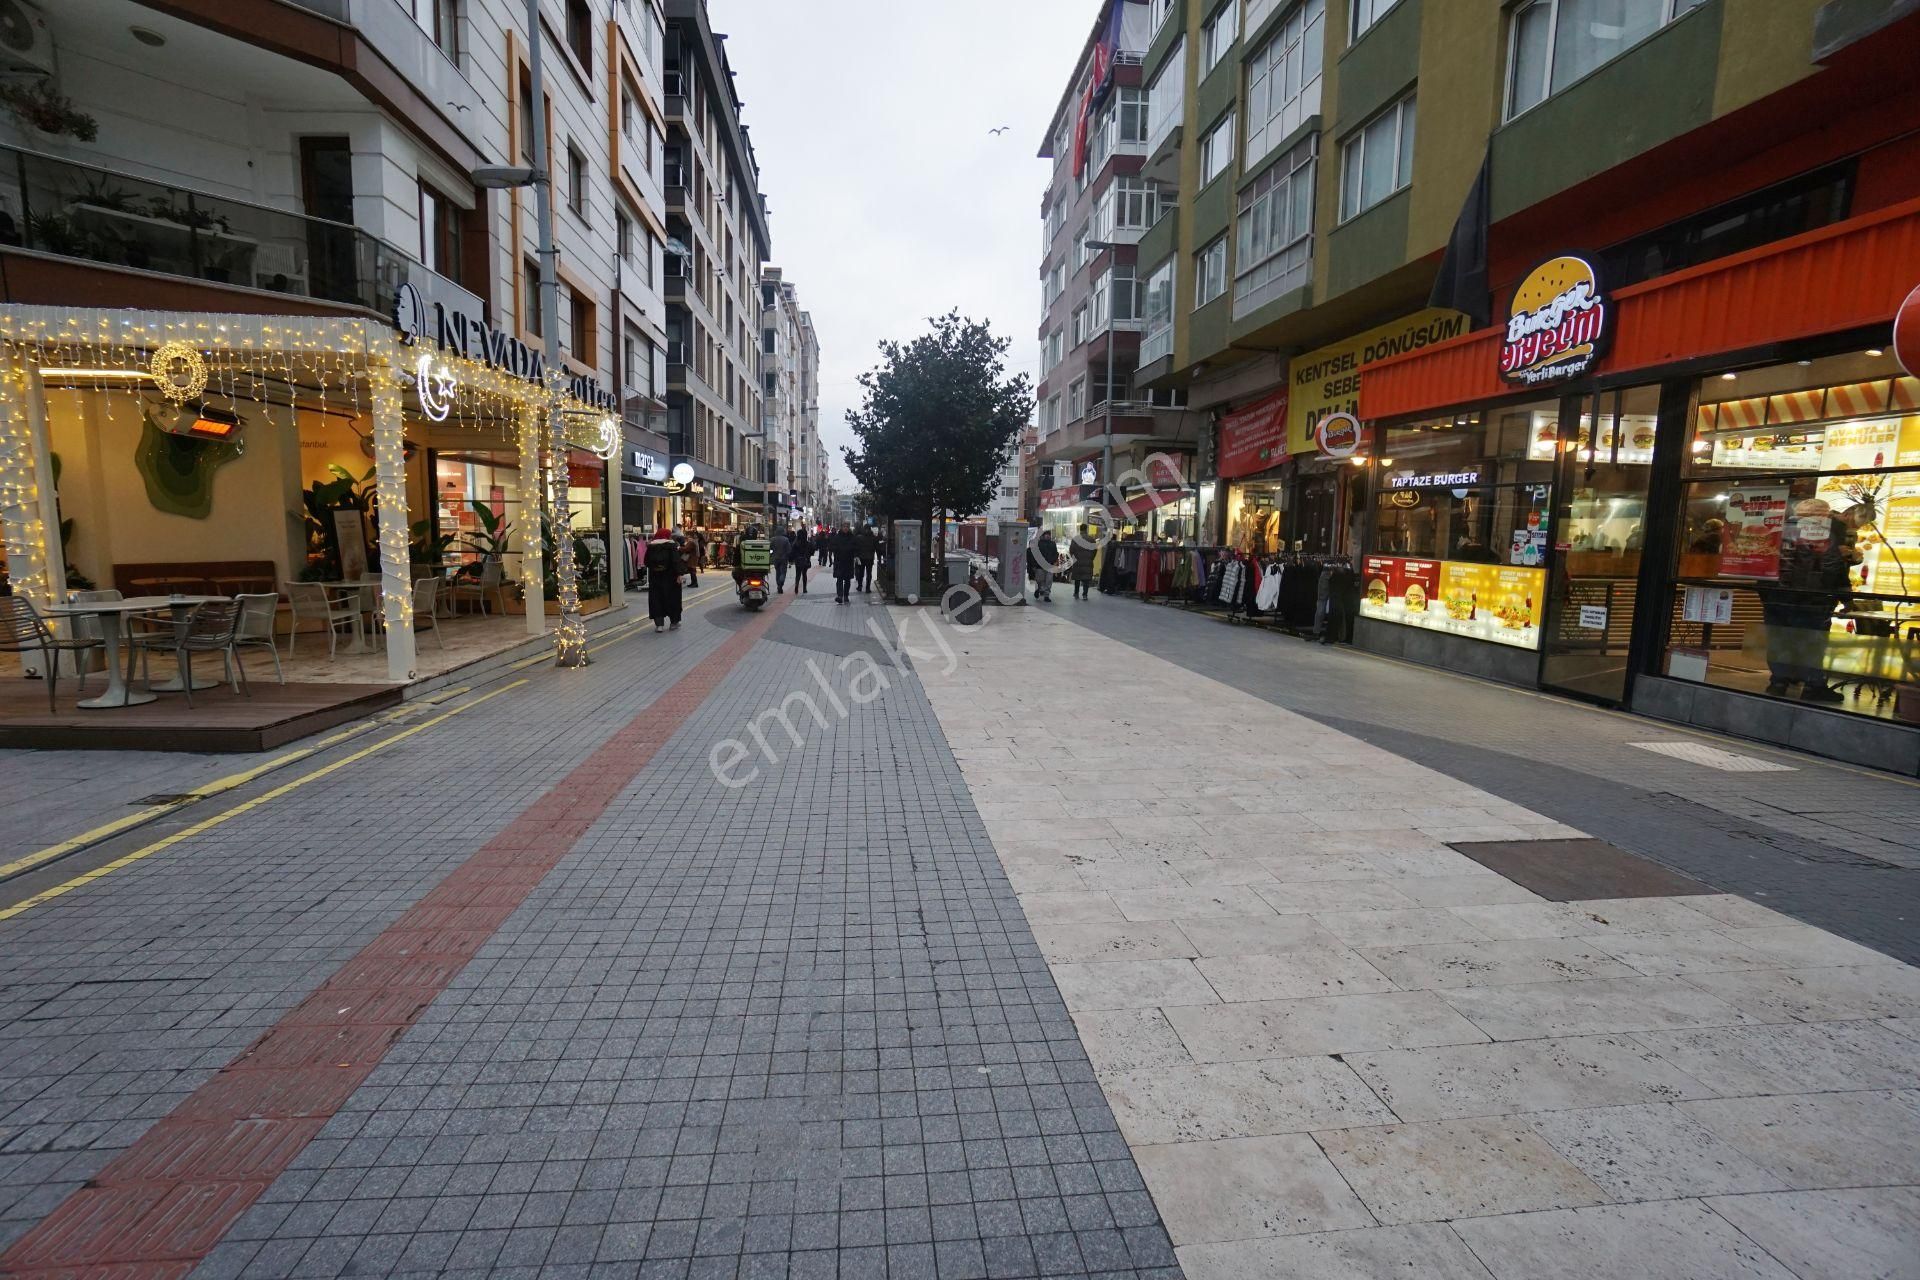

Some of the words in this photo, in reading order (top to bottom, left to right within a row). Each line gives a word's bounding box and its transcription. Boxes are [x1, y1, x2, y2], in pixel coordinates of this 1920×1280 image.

[434, 302, 546, 388] NEVADA
[1296, 352, 1359, 386] KENTSEL
[634, 451, 654, 474] marga
[1391, 475, 1431, 488] TAPTAZE
[1433, 472, 1478, 486] BURGER
